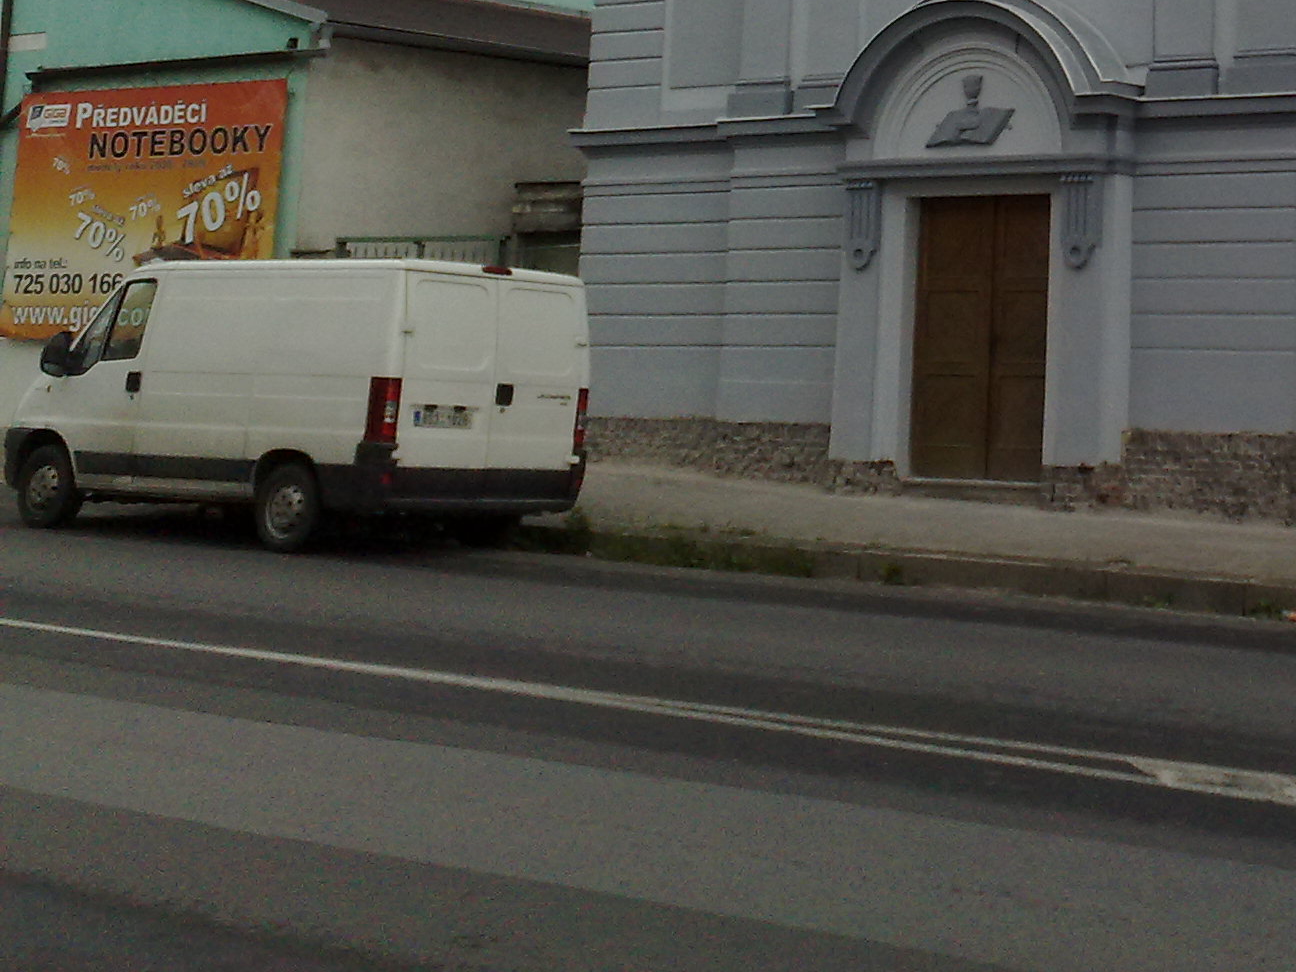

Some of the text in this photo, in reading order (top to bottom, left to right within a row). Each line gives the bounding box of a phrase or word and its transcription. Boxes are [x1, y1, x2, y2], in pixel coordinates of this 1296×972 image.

[76, 100, 207, 129] PŘEDVÁDĚCÍ
[88, 124, 273, 160] NOTEBOOKY
[129, 199, 161, 221] 70%
[176, 172, 262, 245] 70%
[74, 211, 126, 262] 70%
[13, 273, 45, 294] 725
[49, 273, 83, 294] 030
